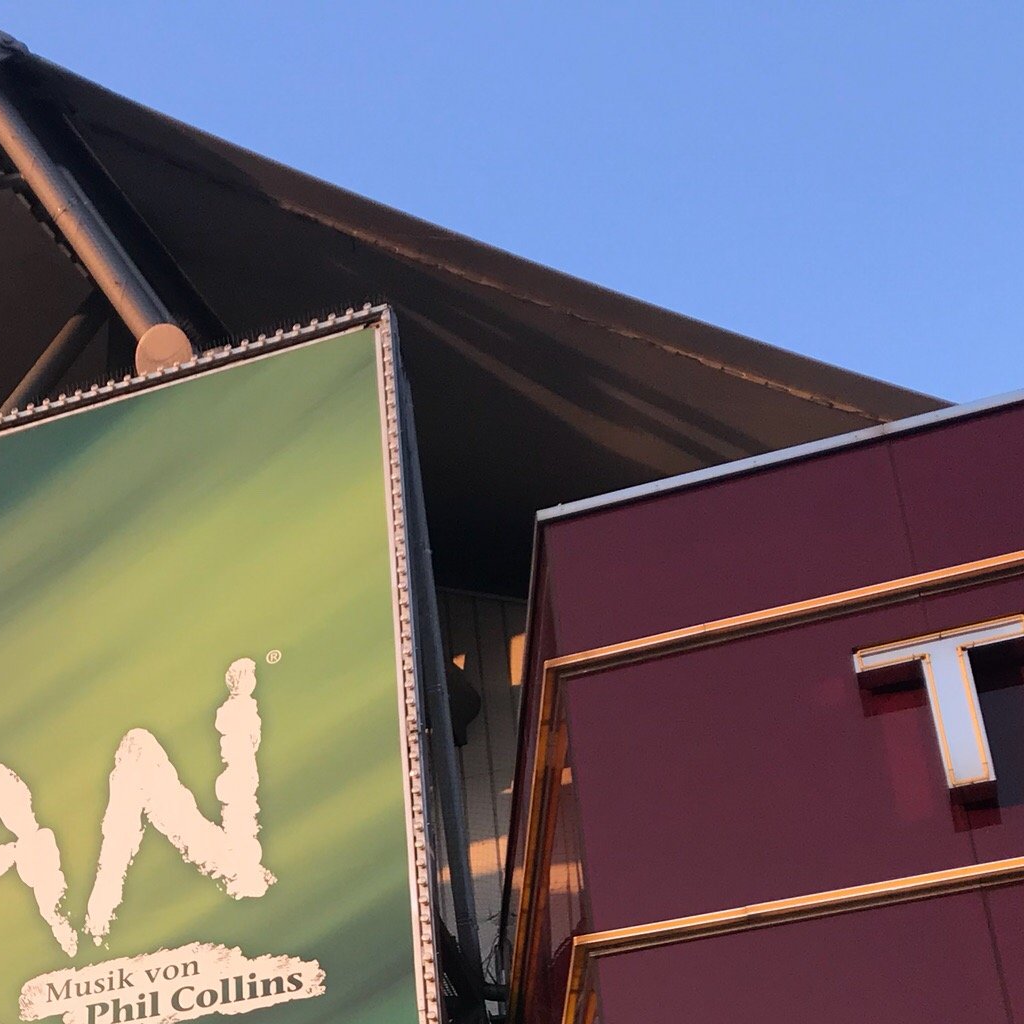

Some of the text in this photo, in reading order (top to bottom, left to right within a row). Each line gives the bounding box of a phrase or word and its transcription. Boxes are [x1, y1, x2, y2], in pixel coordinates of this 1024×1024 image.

[45, 960, 200, 1003] Musik von
[170, 971, 304, 1013] Collins
